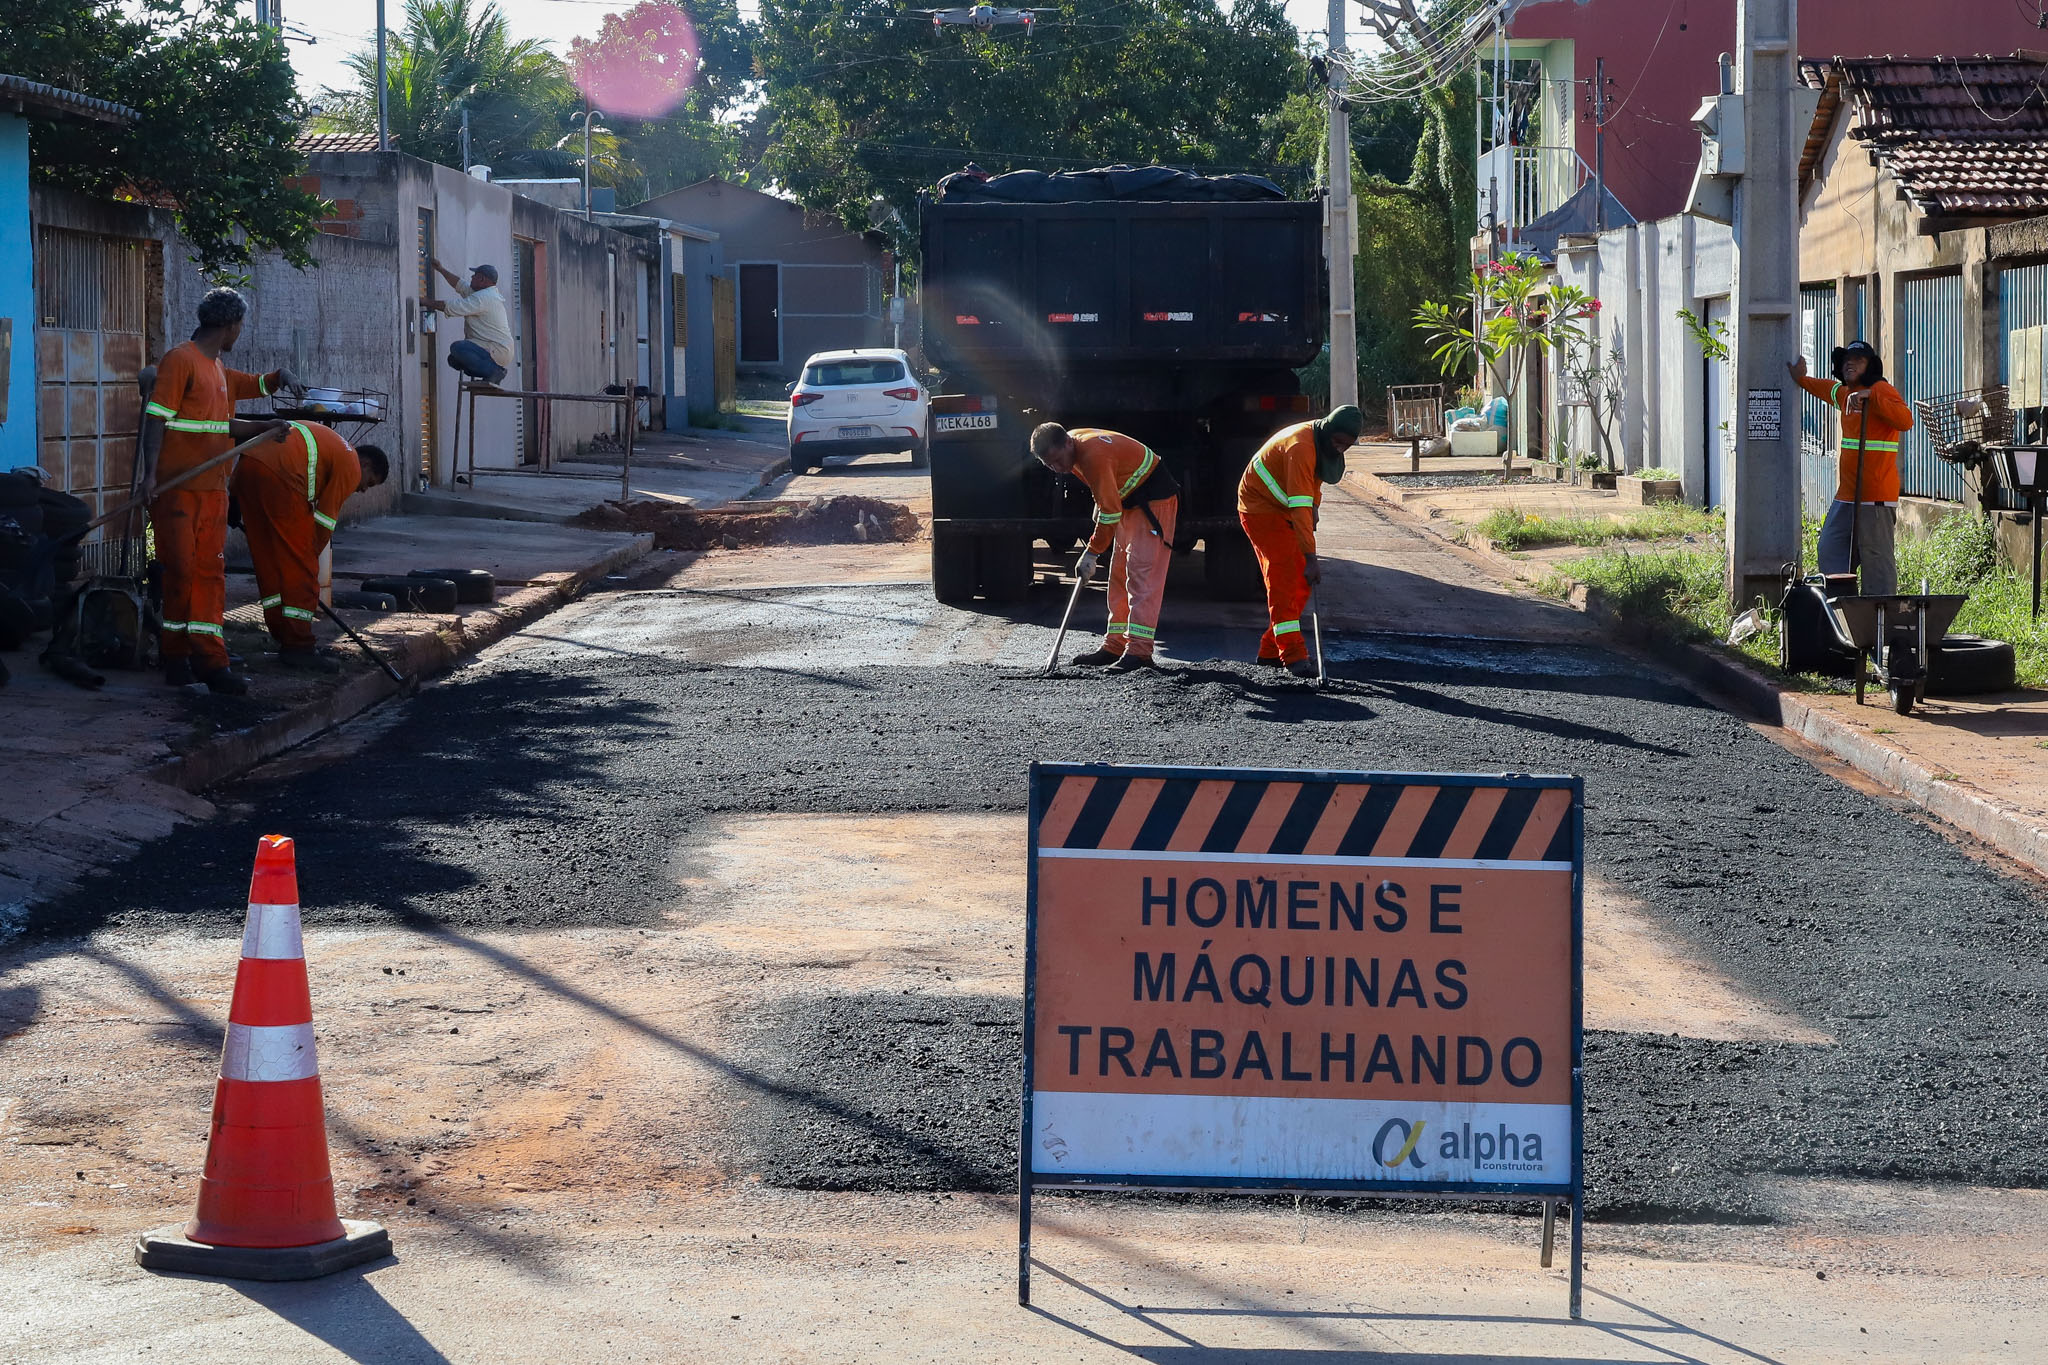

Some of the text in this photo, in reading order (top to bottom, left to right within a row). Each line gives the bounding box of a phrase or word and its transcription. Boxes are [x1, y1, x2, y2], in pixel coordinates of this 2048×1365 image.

[1141, 875, 1463, 934] HOMENS E
[1132, 939, 1469, 1010] MÁQUINAS
[1057, 1024, 1544, 1089] TRABALHANDO
[1440, 1122, 1543, 1169] alpha
[1482, 1161, 1543, 1171] construtora
